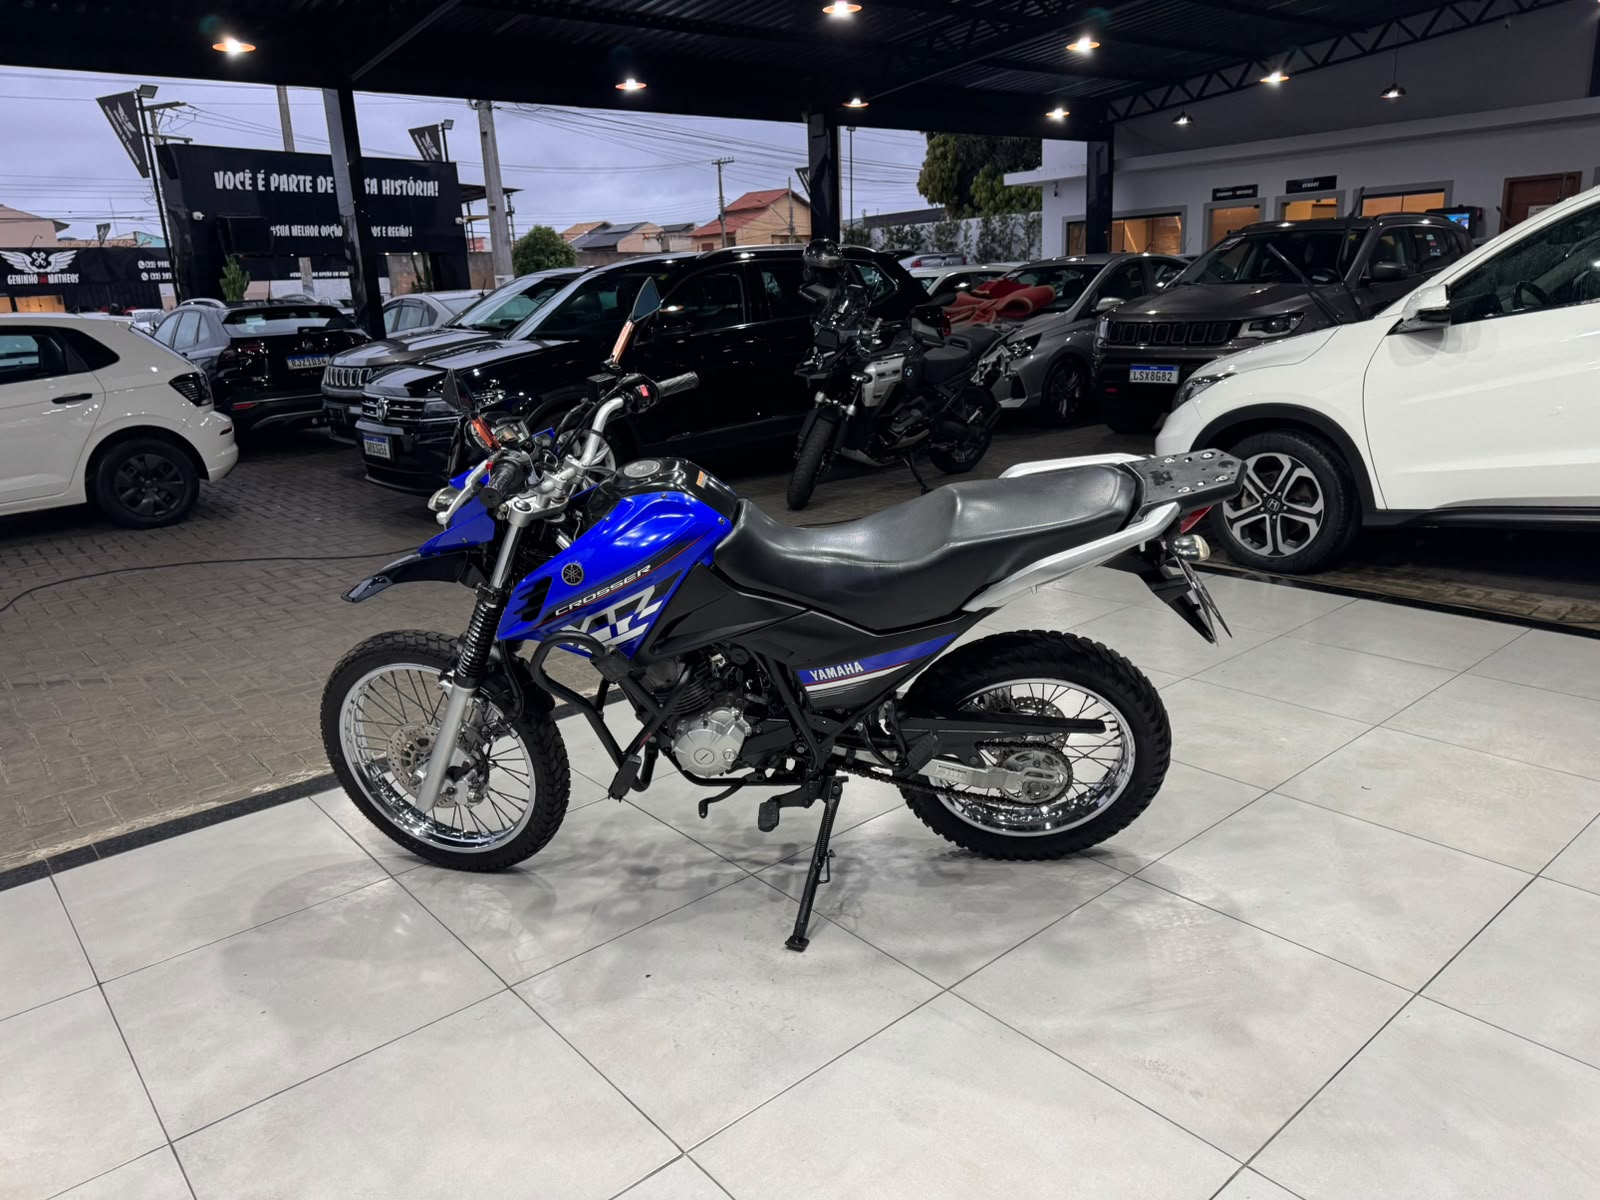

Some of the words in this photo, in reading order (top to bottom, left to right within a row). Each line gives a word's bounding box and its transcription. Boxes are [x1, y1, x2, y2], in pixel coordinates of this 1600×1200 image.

[214, 169, 253, 190] VOCÊ
[257, 169, 266, 191] É
[270, 173, 313, 193] PARTE
[316, 175, 335, 193] DE
[381, 176, 439, 197] HISTÓRIA!
[291, 225, 320, 237] MELHOR
[7, 274, 39, 285] GENINHO
[47, 273, 79, 284] MATHEUS
[1133, 370, 1173, 382] LSX8G82
[555, 564, 652, 616] CROSSER
[809, 661, 865, 681] YAMAHA
